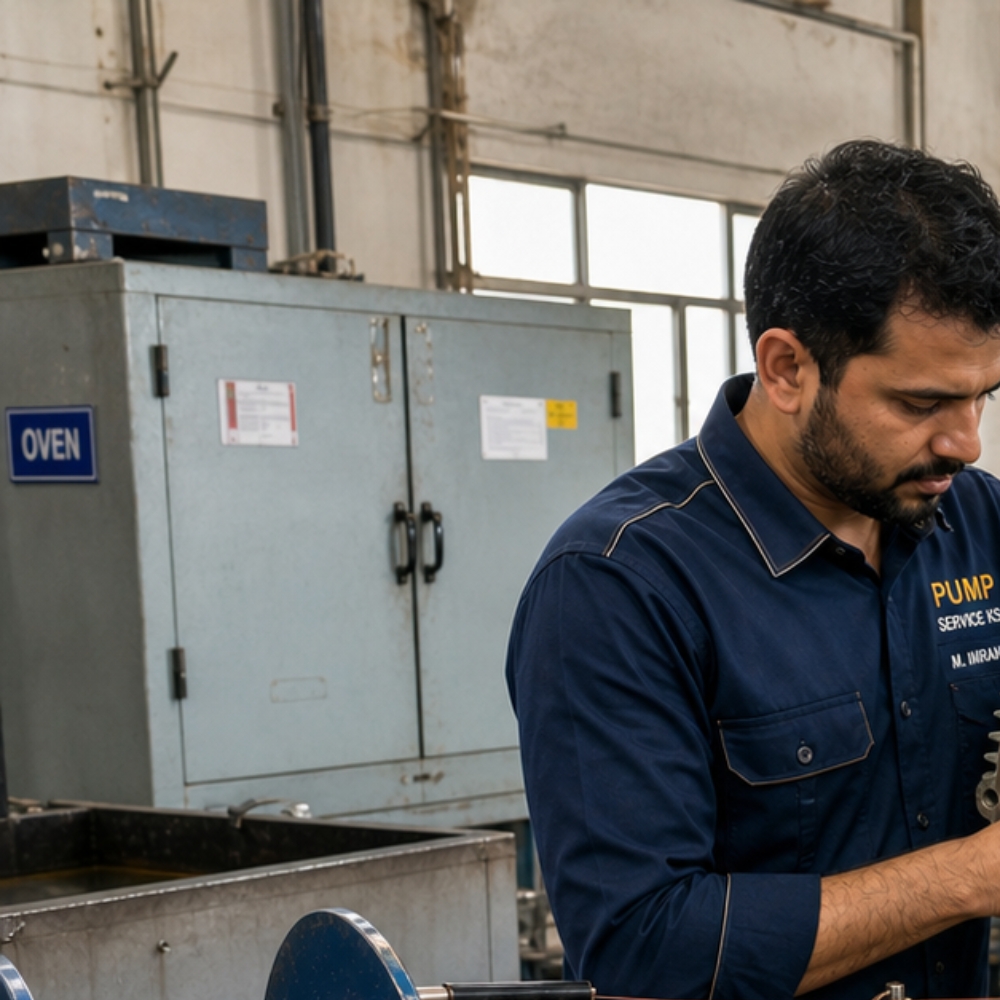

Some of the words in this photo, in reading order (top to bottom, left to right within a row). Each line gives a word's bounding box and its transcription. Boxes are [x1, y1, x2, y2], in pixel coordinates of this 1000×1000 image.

[21, 427, 80, 461] OVEN
[931, 574, 994, 608] PUMP
[938, 611, 985, 632] SERVICE
